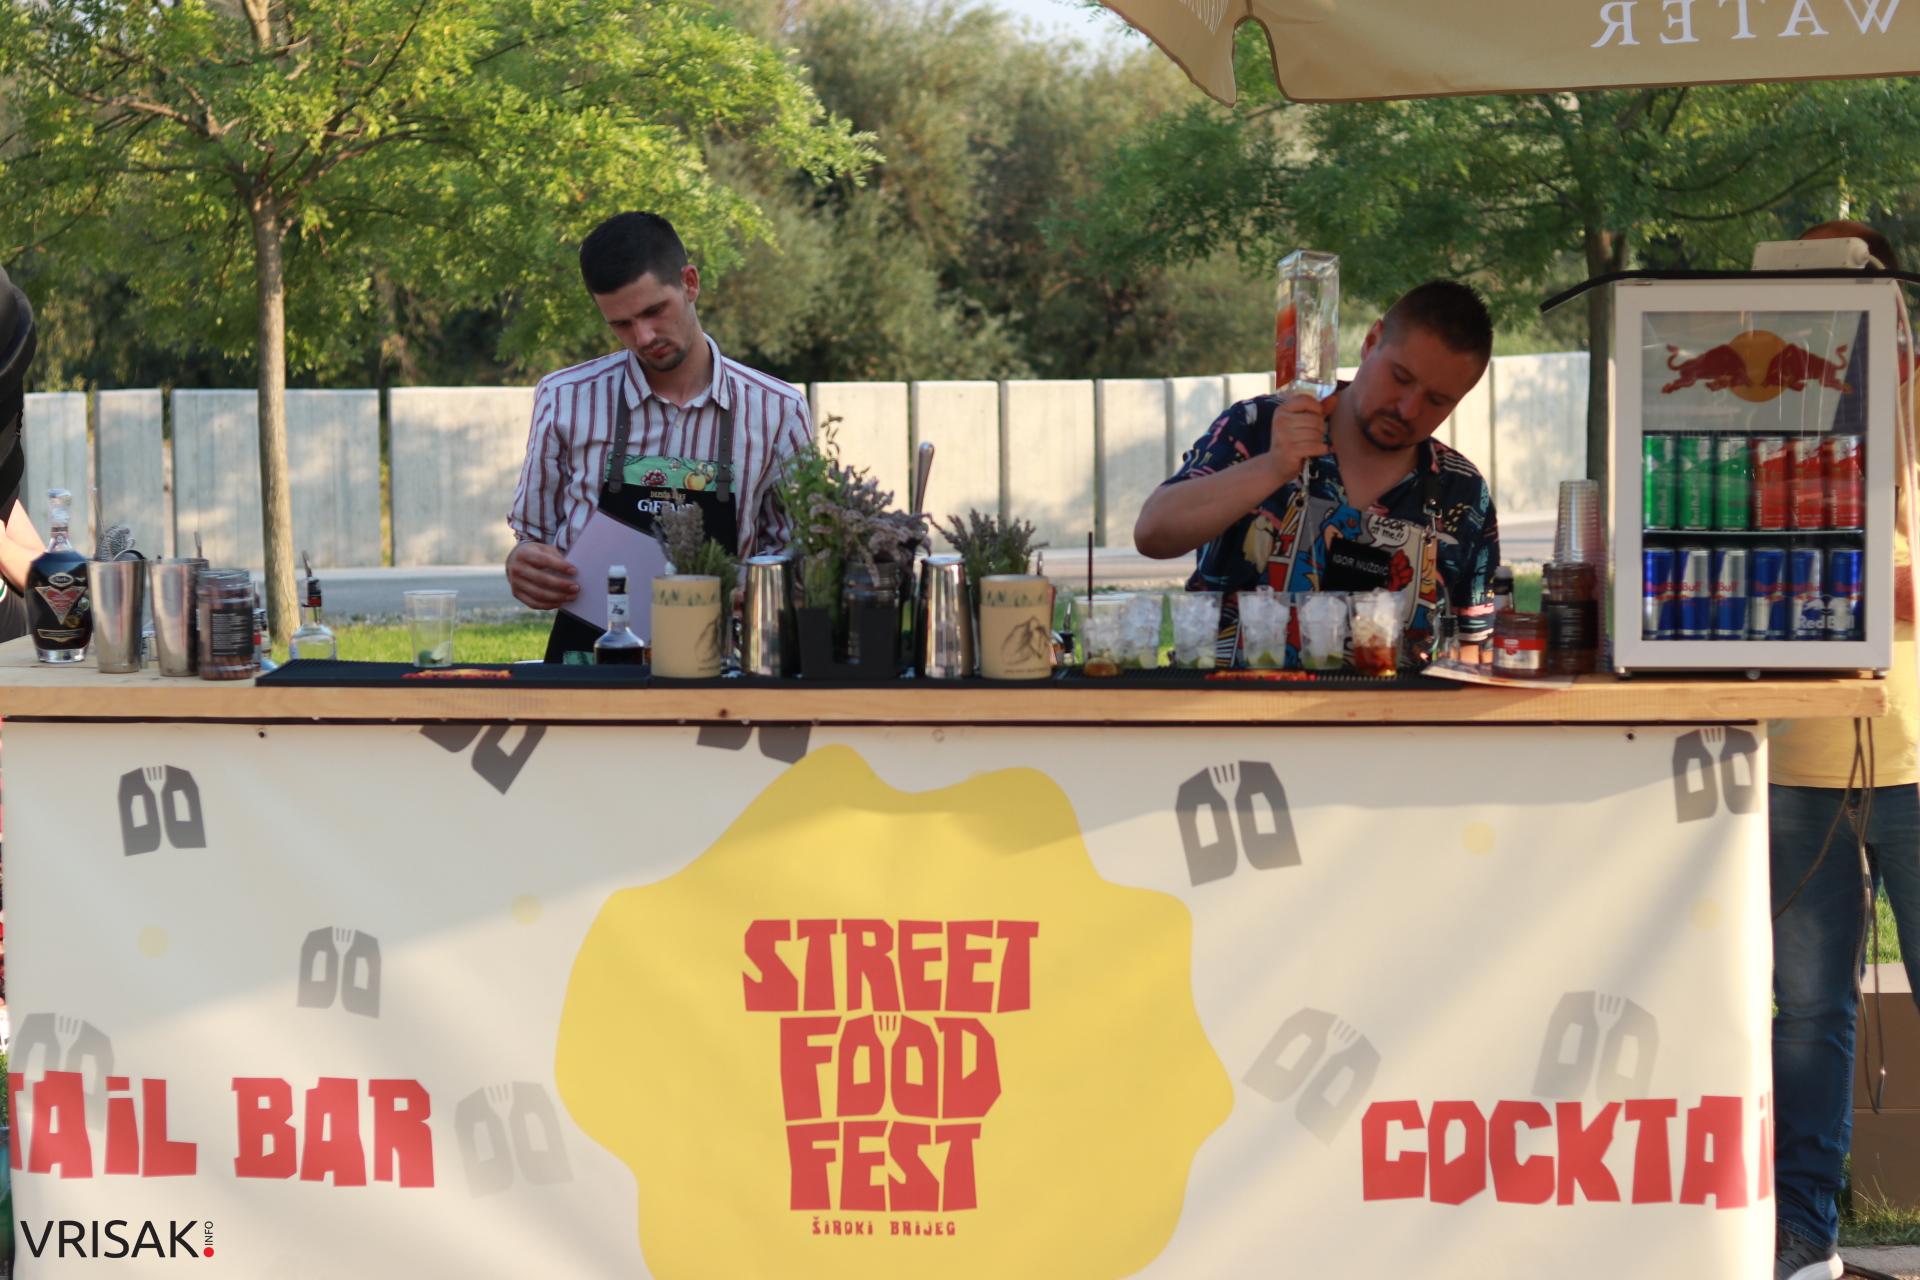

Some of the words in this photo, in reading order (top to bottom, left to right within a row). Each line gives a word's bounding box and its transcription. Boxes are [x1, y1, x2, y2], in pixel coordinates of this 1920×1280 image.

[1332, 553, 1355, 568] IGOR
[1800, 615, 1824, 628] Red
[743, 919, 1039, 1013] STREET
[780, 1014, 1001, 1121] FOOD
[231, 1076, 435, 1188] BAR
[786, 1120, 981, 1212] FEST
